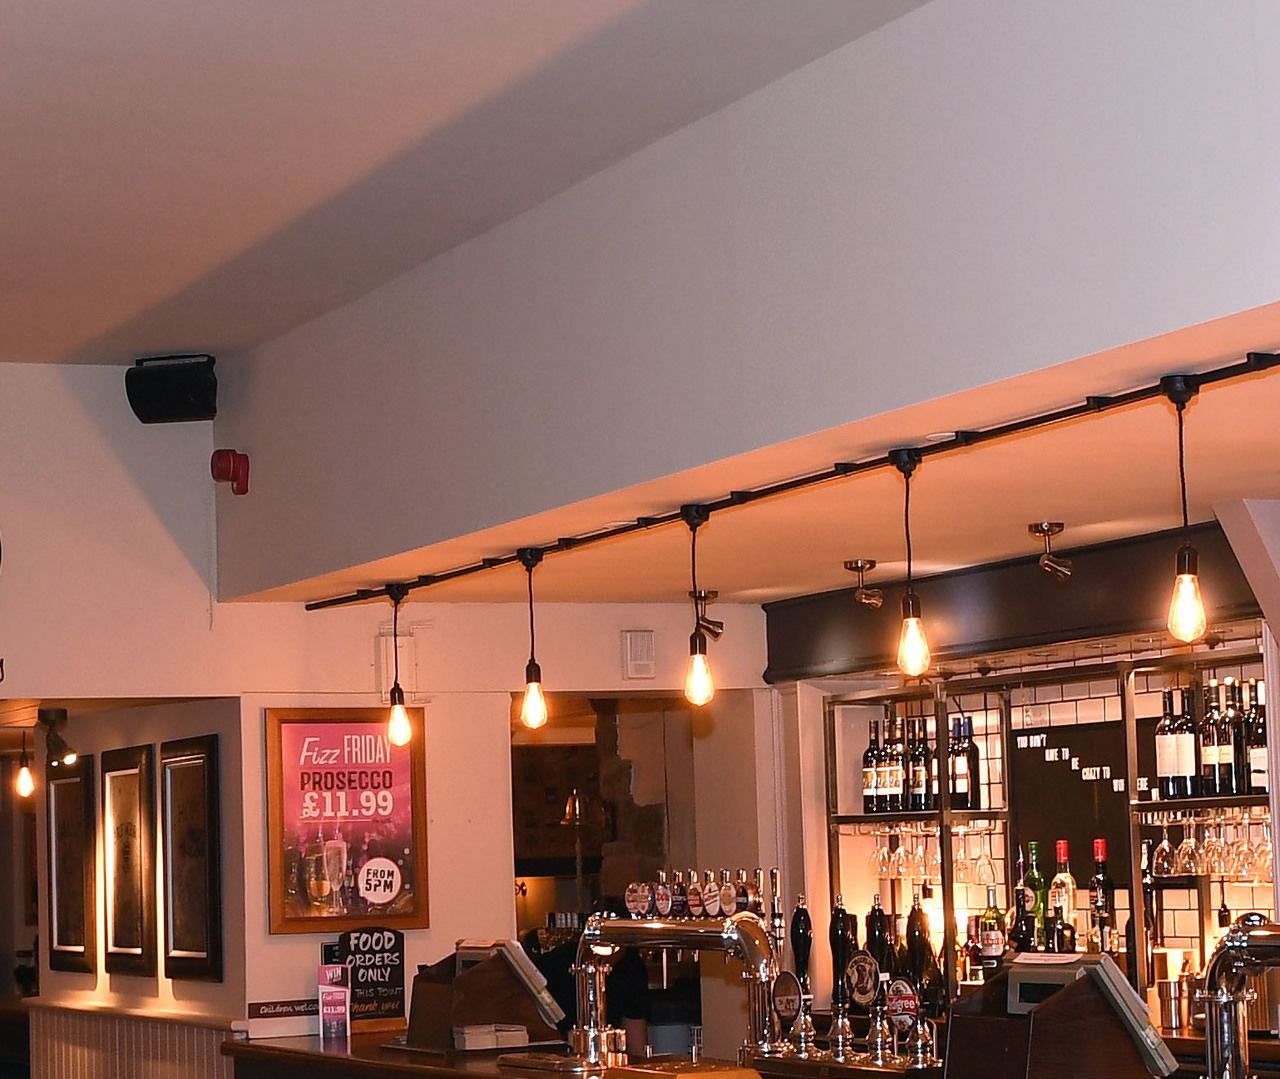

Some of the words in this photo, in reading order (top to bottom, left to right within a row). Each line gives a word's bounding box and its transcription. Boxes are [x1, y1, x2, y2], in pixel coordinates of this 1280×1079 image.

[299, 737, 341, 766] Fizz
[343, 734, 392, 764] FRIDAY
[300, 770, 393, 791] PROSECCO
[300, 790, 394, 819] £11.99
[365, 868, 395, 881] FROM
[364, 879, 394, 894] 5PM
[349, 930, 395, 952] FOOD
[345, 951, 400, 968] ORDERS
[325, 966, 342, 981] WIN
[357, 966, 392, 983] ONLY
[354, 988, 375, 999] THIS
